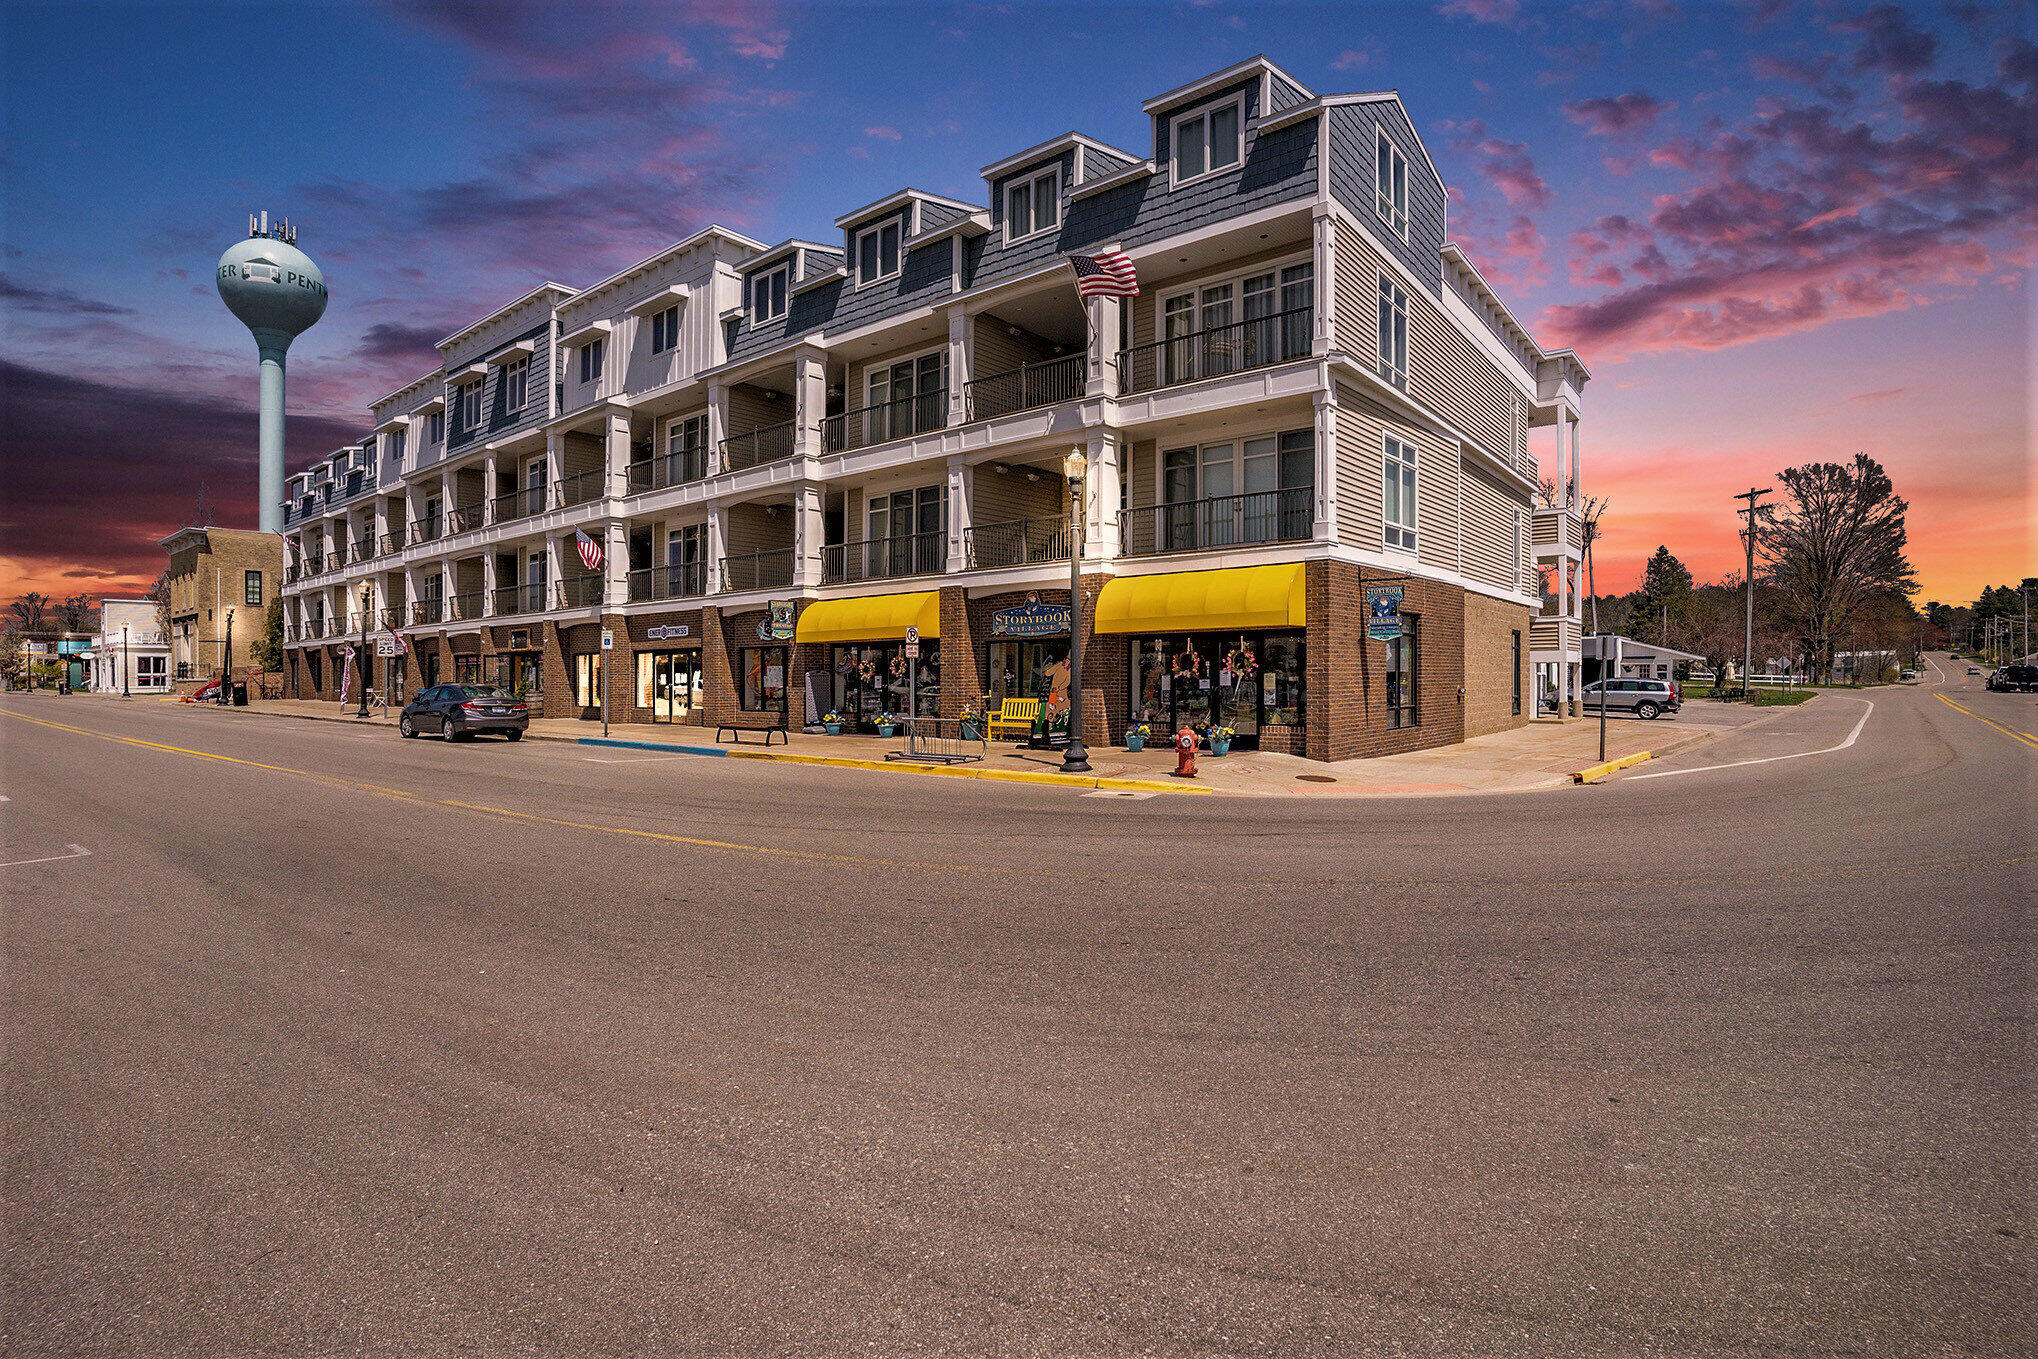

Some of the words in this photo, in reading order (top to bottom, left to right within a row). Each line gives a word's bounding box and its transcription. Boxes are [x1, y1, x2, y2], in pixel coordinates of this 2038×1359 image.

[995, 610, 1071, 625] STORYBOOK
[1010, 624, 1057, 632] VILLAGE
[378, 646, 394, 654] 25
